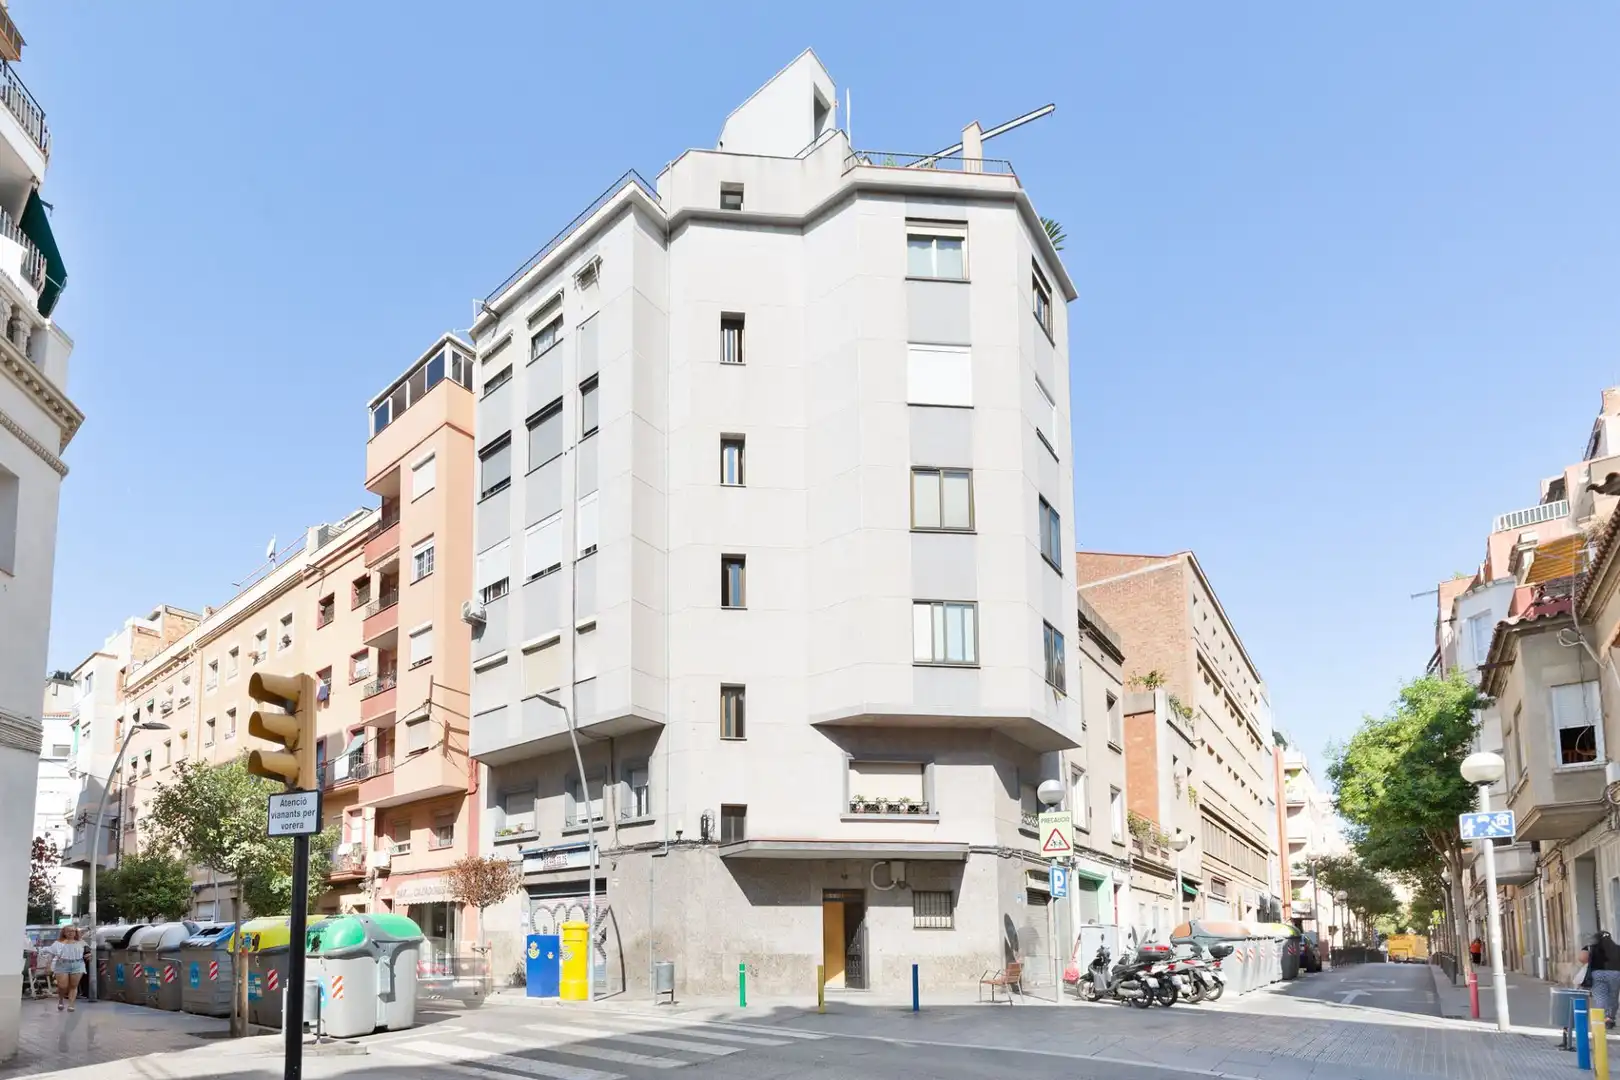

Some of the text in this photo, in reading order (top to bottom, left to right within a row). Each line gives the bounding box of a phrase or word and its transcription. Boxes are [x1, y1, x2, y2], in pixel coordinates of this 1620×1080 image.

[280, 797, 307, 807] Atenció
[271, 809, 315, 819] vianants per
[281, 822, 304, 830] vorera
[1054, 870, 1063, 894] P
